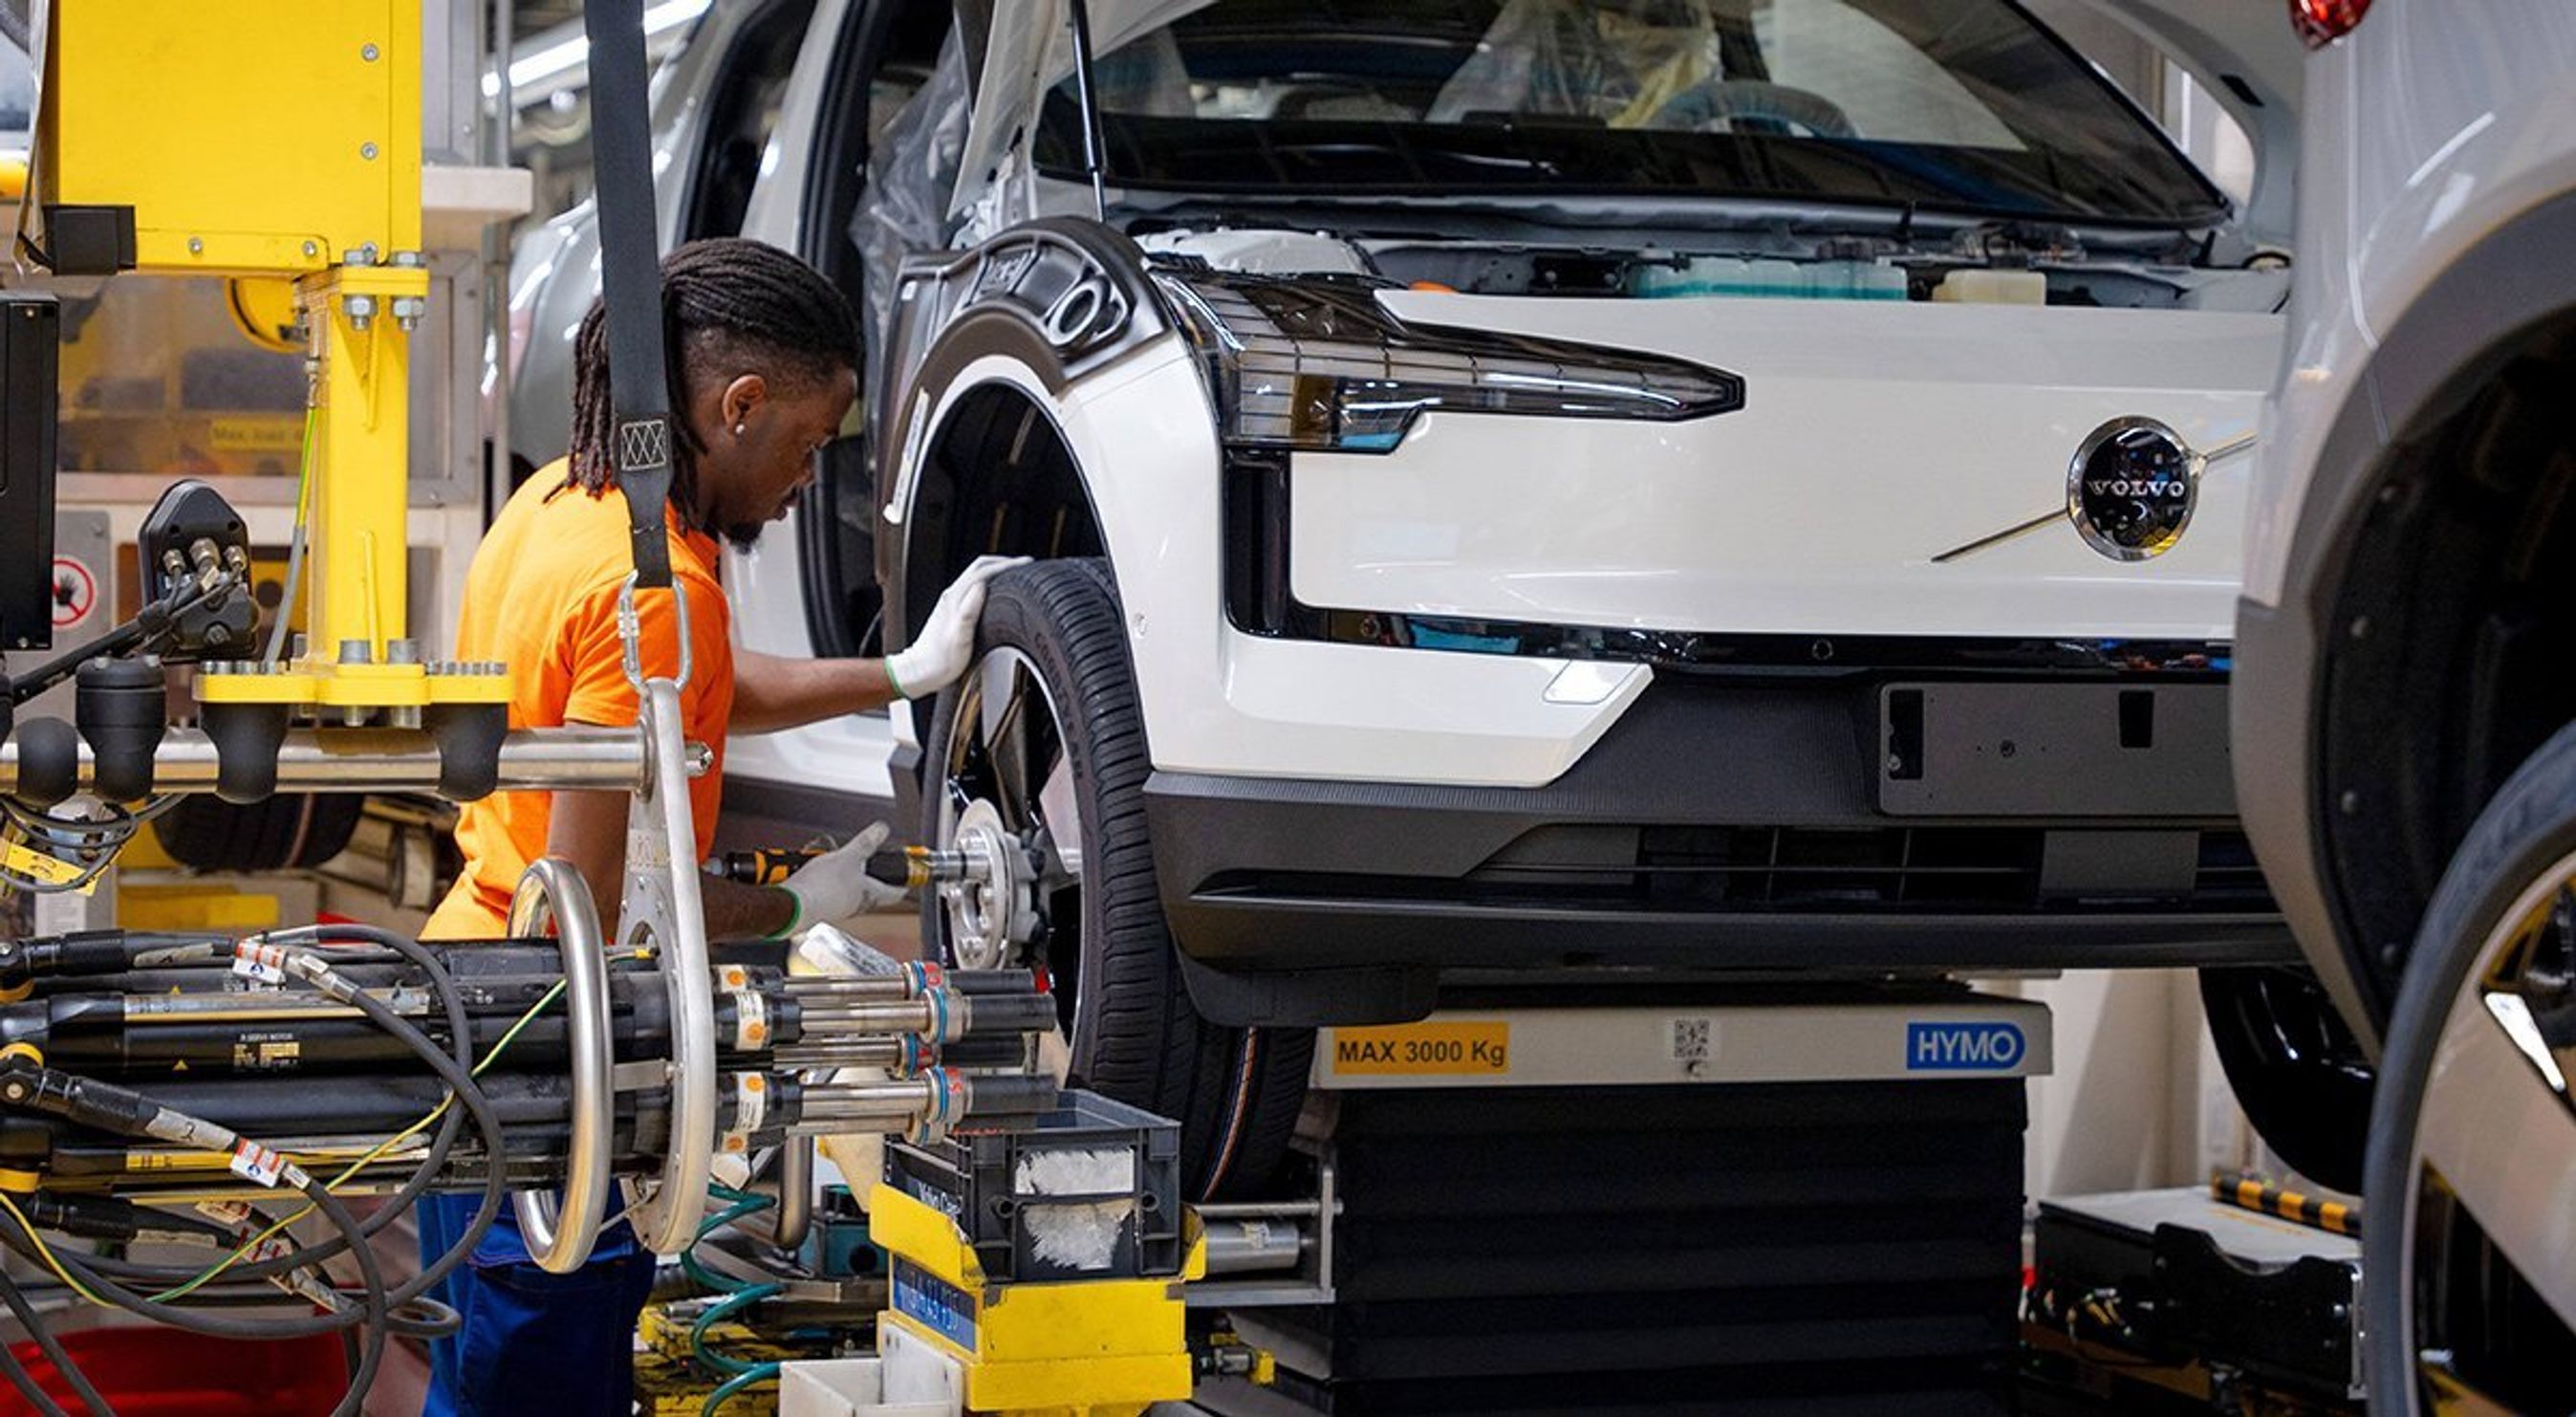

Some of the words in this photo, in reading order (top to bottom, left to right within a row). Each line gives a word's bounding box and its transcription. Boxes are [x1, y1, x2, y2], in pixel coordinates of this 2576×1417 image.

[2087, 480, 2186, 497] VOLVO
[1338, 1040, 1396, 1062] MAX
[1405, 1040, 1463, 1062] 3000
[1471, 1040, 1505, 1068] Kg
[1917, 1031, 2017, 1062] HYMO
